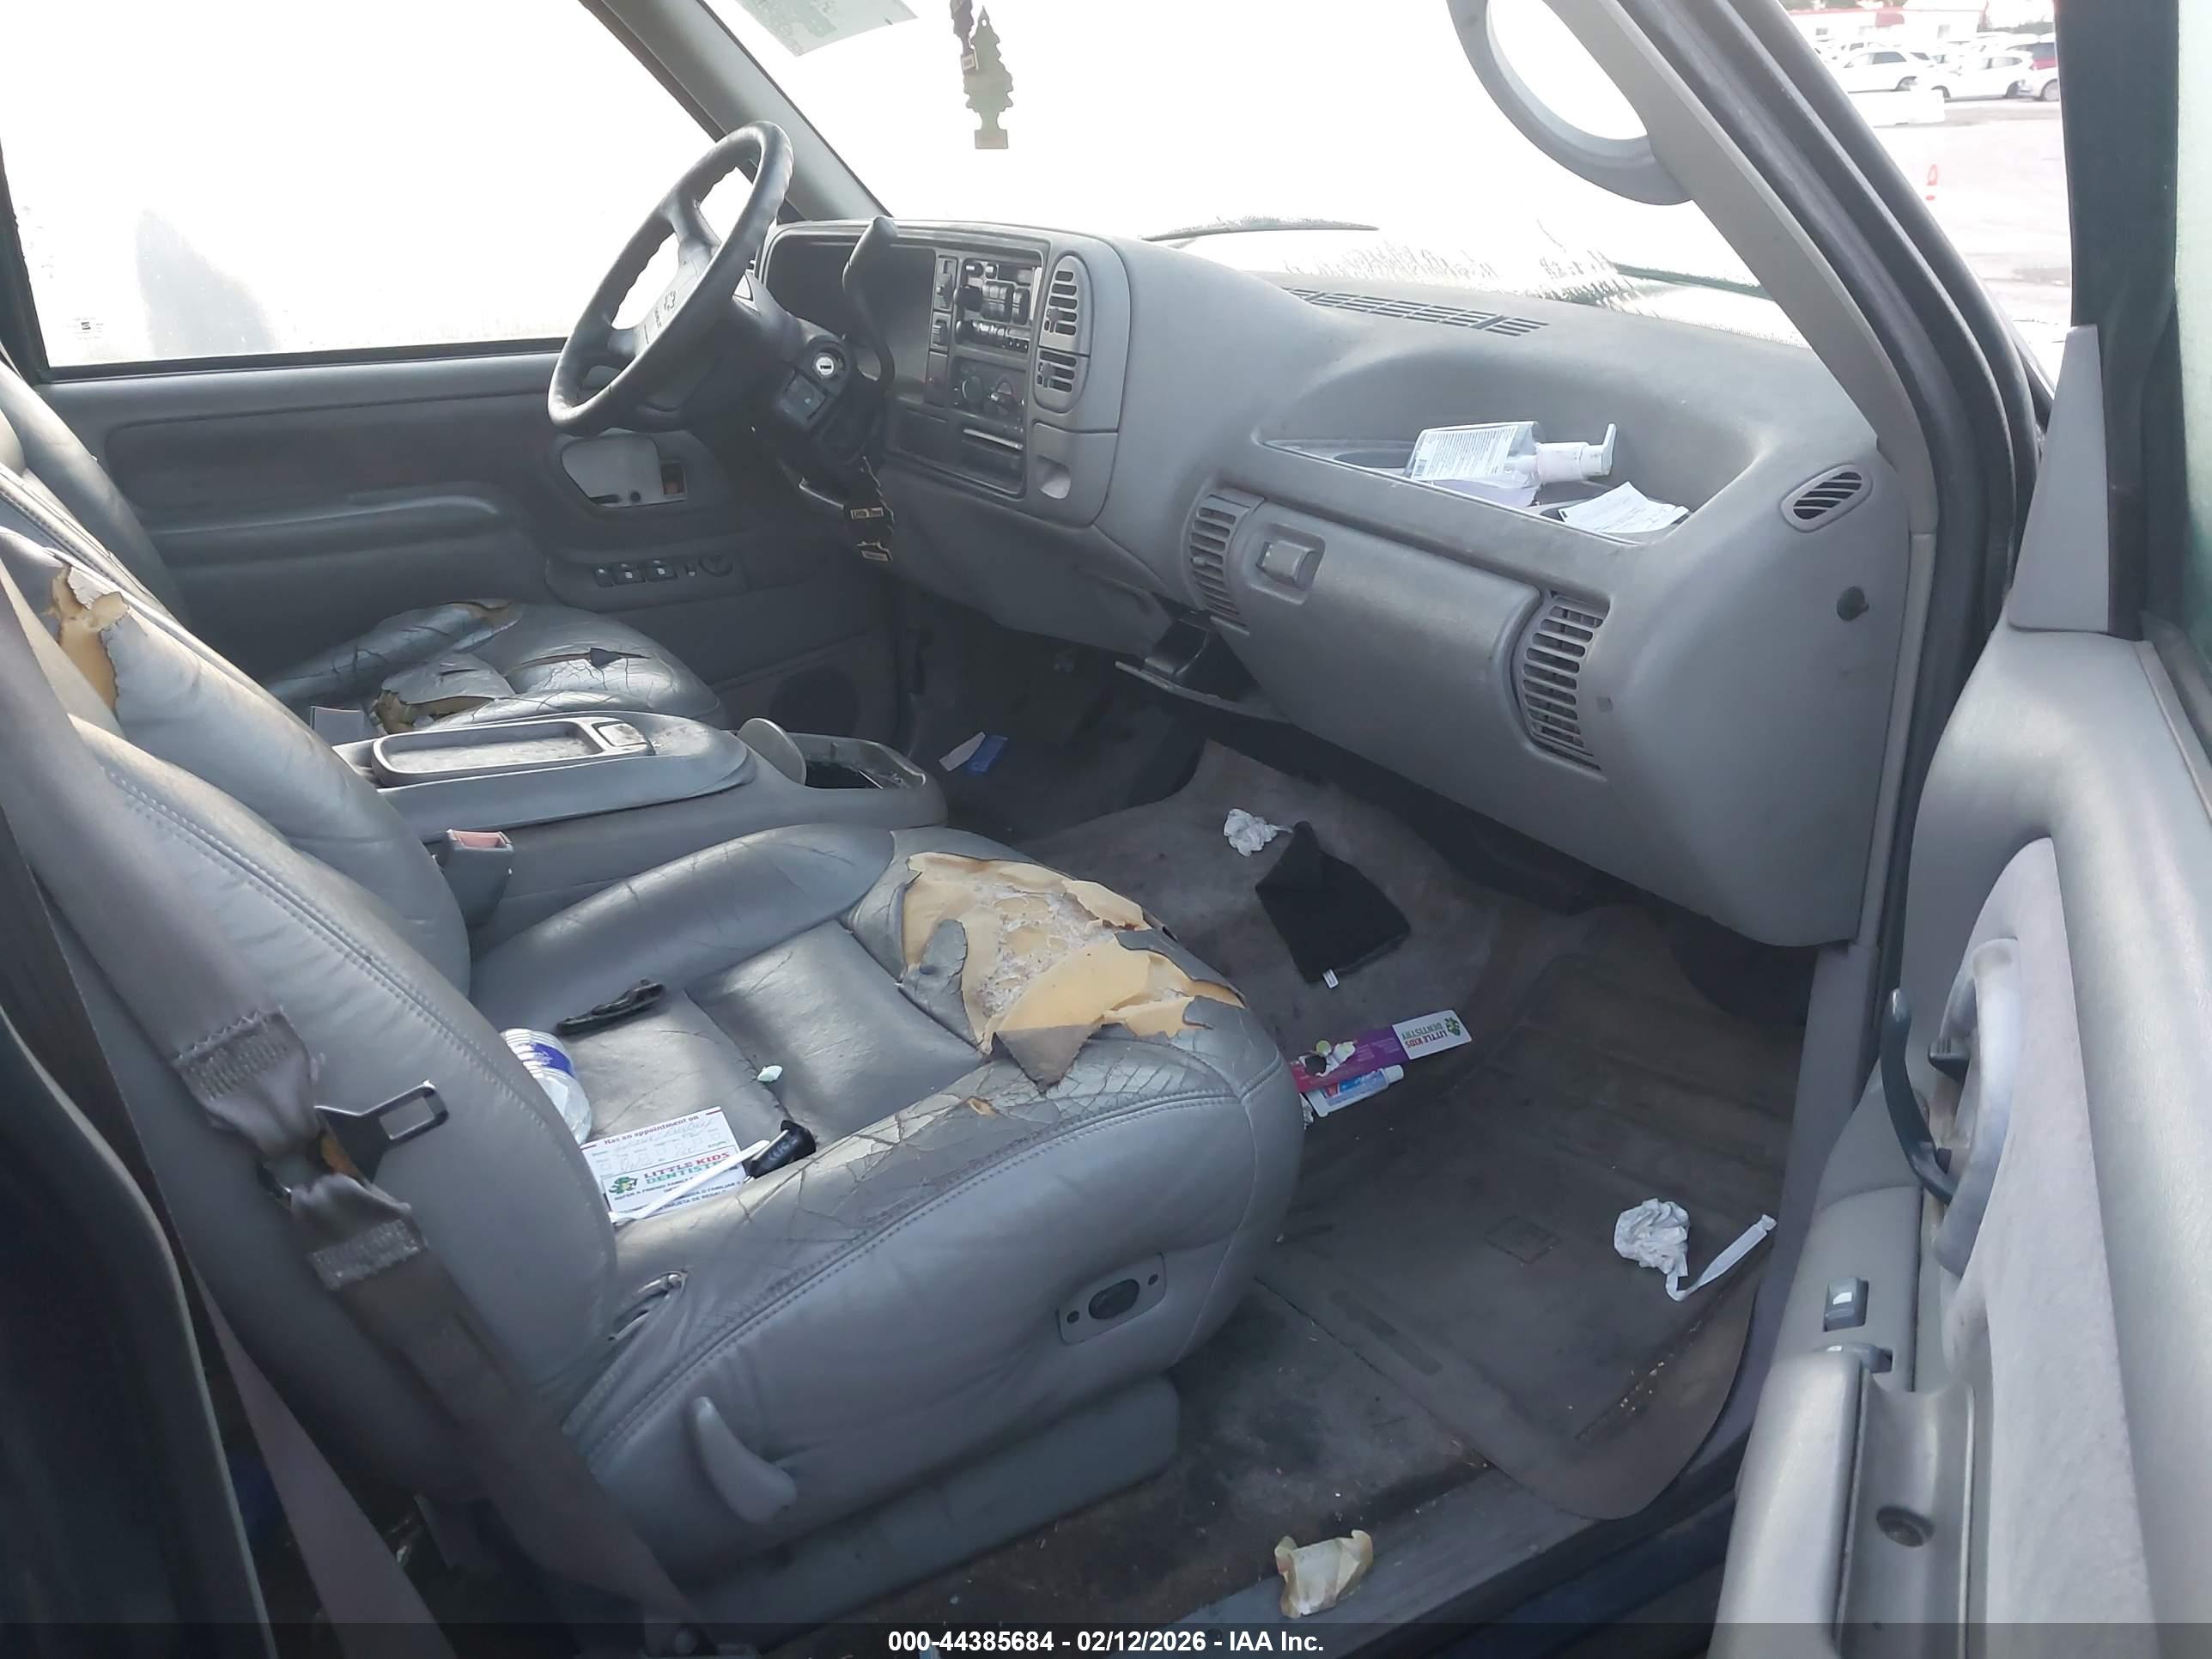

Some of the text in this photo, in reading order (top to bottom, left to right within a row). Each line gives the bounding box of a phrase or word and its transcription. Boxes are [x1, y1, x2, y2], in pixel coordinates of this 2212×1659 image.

[1405, 1030, 1448, 1048] LITTLE KIDS
[604, 1137, 621, 1146] Has
[634, 1118, 688, 1138] appointment
[644, 1160, 695, 1178] LITTLE
[696, 1152, 731, 1165] KIDS
